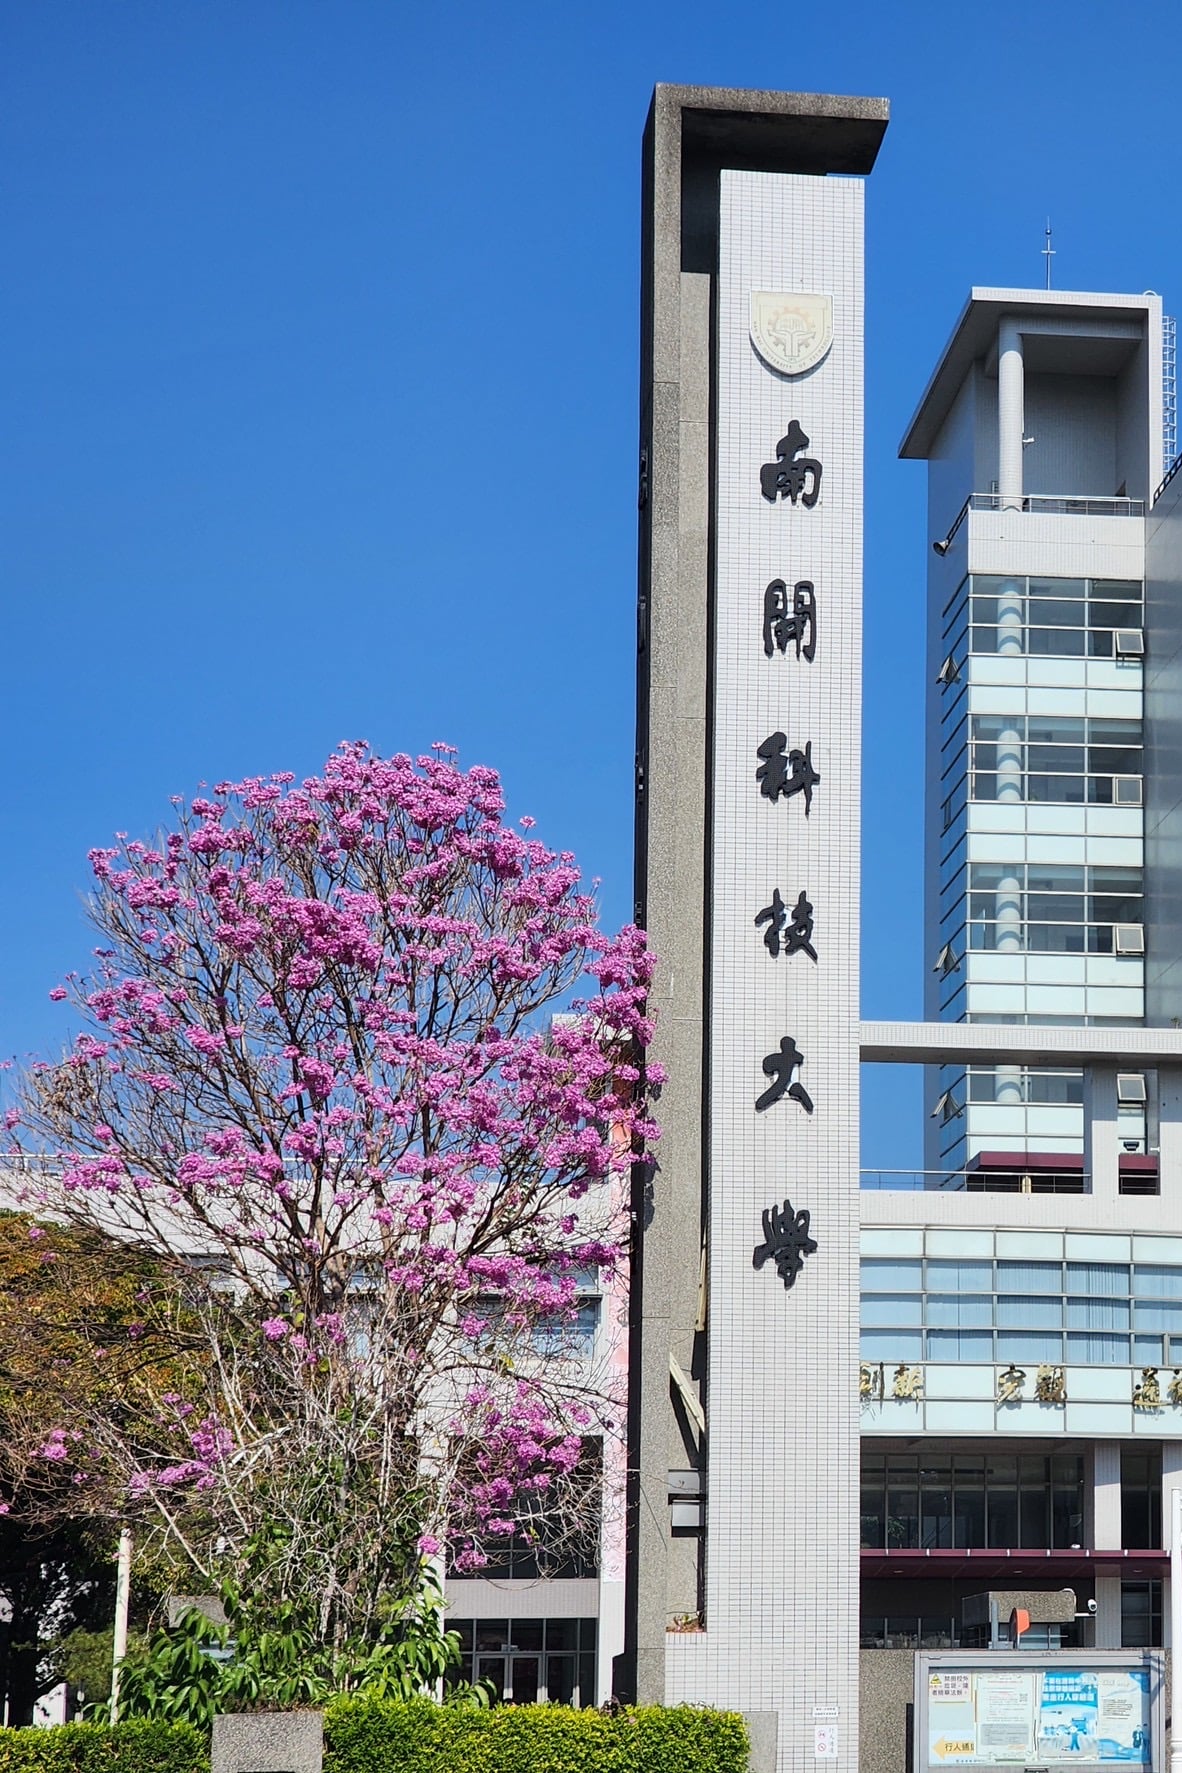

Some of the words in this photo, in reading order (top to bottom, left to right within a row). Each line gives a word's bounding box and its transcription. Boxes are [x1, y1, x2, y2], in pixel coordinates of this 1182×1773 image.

[752, 419, 823, 1290] 南開科技大學
